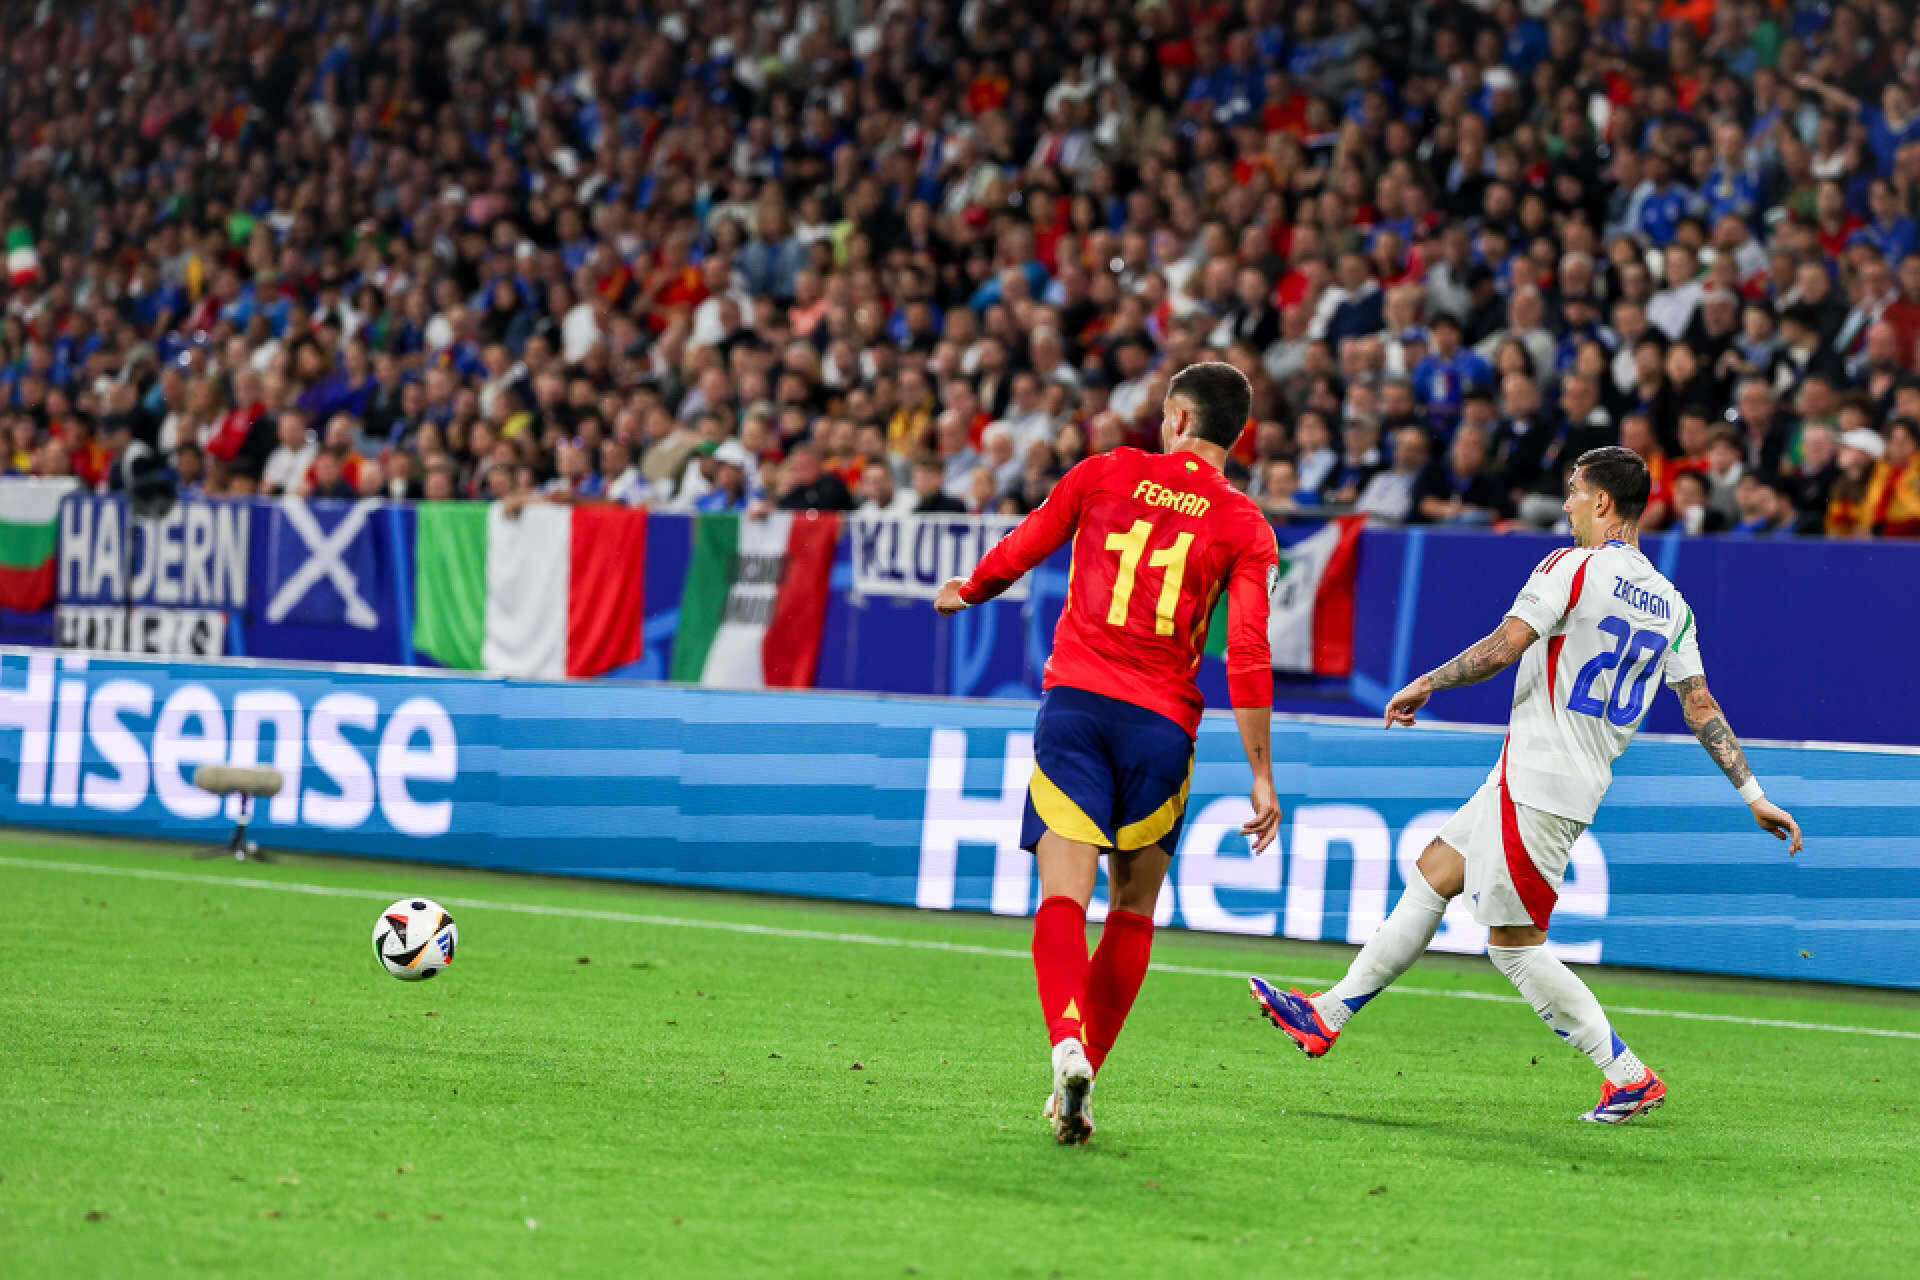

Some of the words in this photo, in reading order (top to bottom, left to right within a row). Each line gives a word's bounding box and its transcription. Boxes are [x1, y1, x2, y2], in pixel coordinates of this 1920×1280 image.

[1132, 479, 1211, 518] FERRAN
[1104, 519, 1195, 637] 11
[1612, 575, 1671, 621] ZACCAGNI
[1566, 615, 1669, 727] 20
